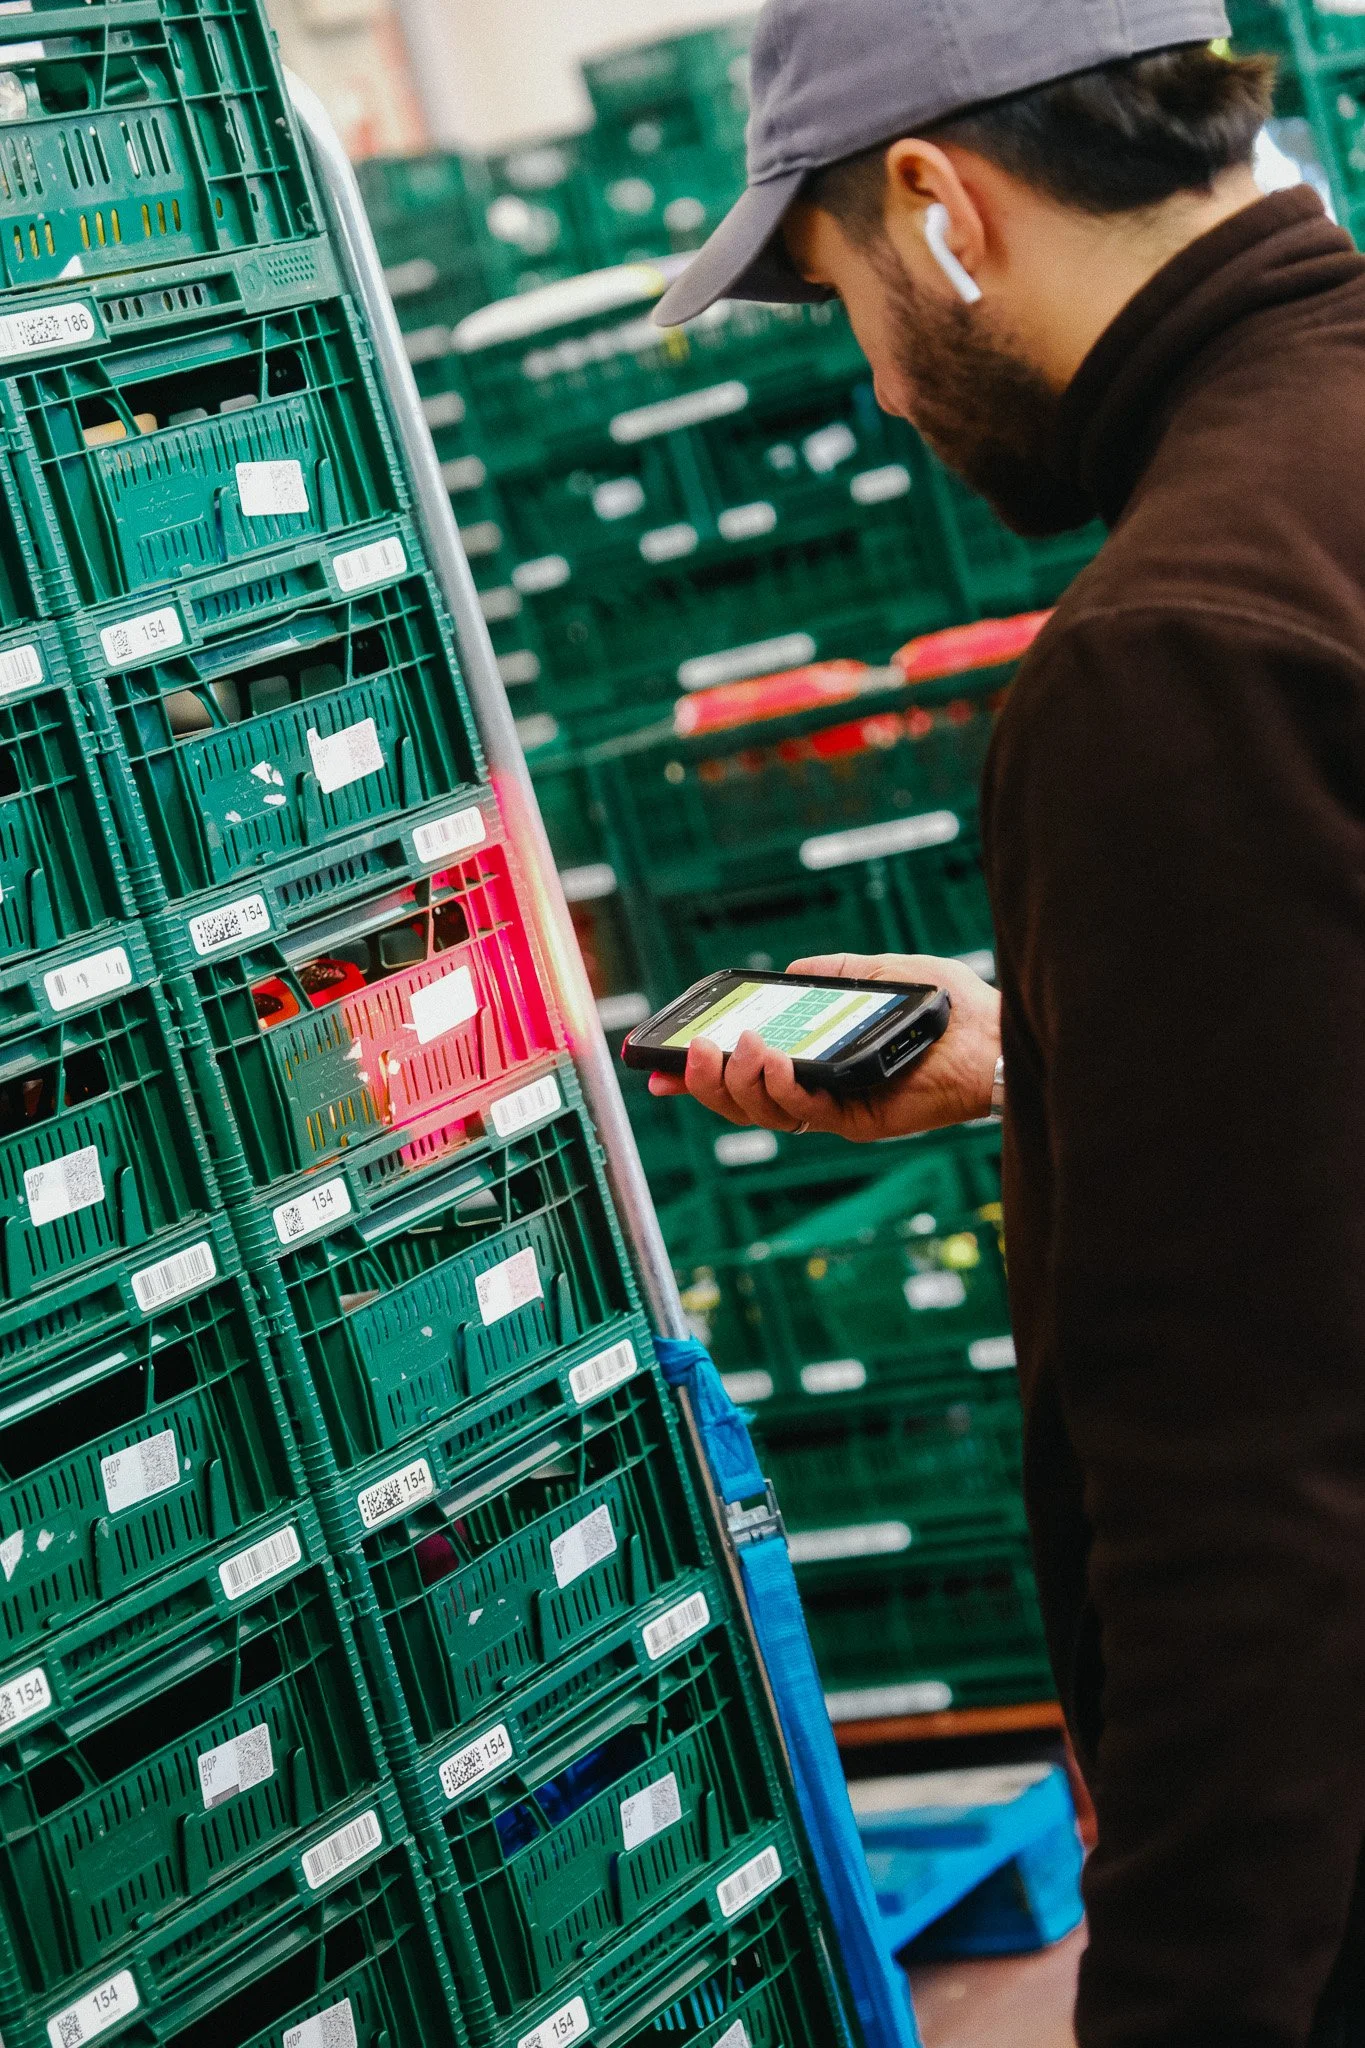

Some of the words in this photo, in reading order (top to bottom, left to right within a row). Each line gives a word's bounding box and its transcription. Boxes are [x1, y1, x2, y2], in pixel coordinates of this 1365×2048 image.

[64, 313, 89, 333] 186
[142, 619, 166, 640] 154
[242, 902, 263, 922] 154
[27, 1171, 45, 1190] HOP
[312, 1188, 334, 1211] 154
[104, 1457, 121, 1477] HOP
[403, 1467, 426, 1492] 154
[16, 1677, 43, 1705] 154
[483, 1733, 505, 1759] 154
[200, 1754, 217, 1774] HOP
[202, 1771, 213, 1787] 51
[93, 1984, 118, 2012] 154
[552, 2011, 575, 2039] 154
[286, 2030, 302, 2048] HOP
